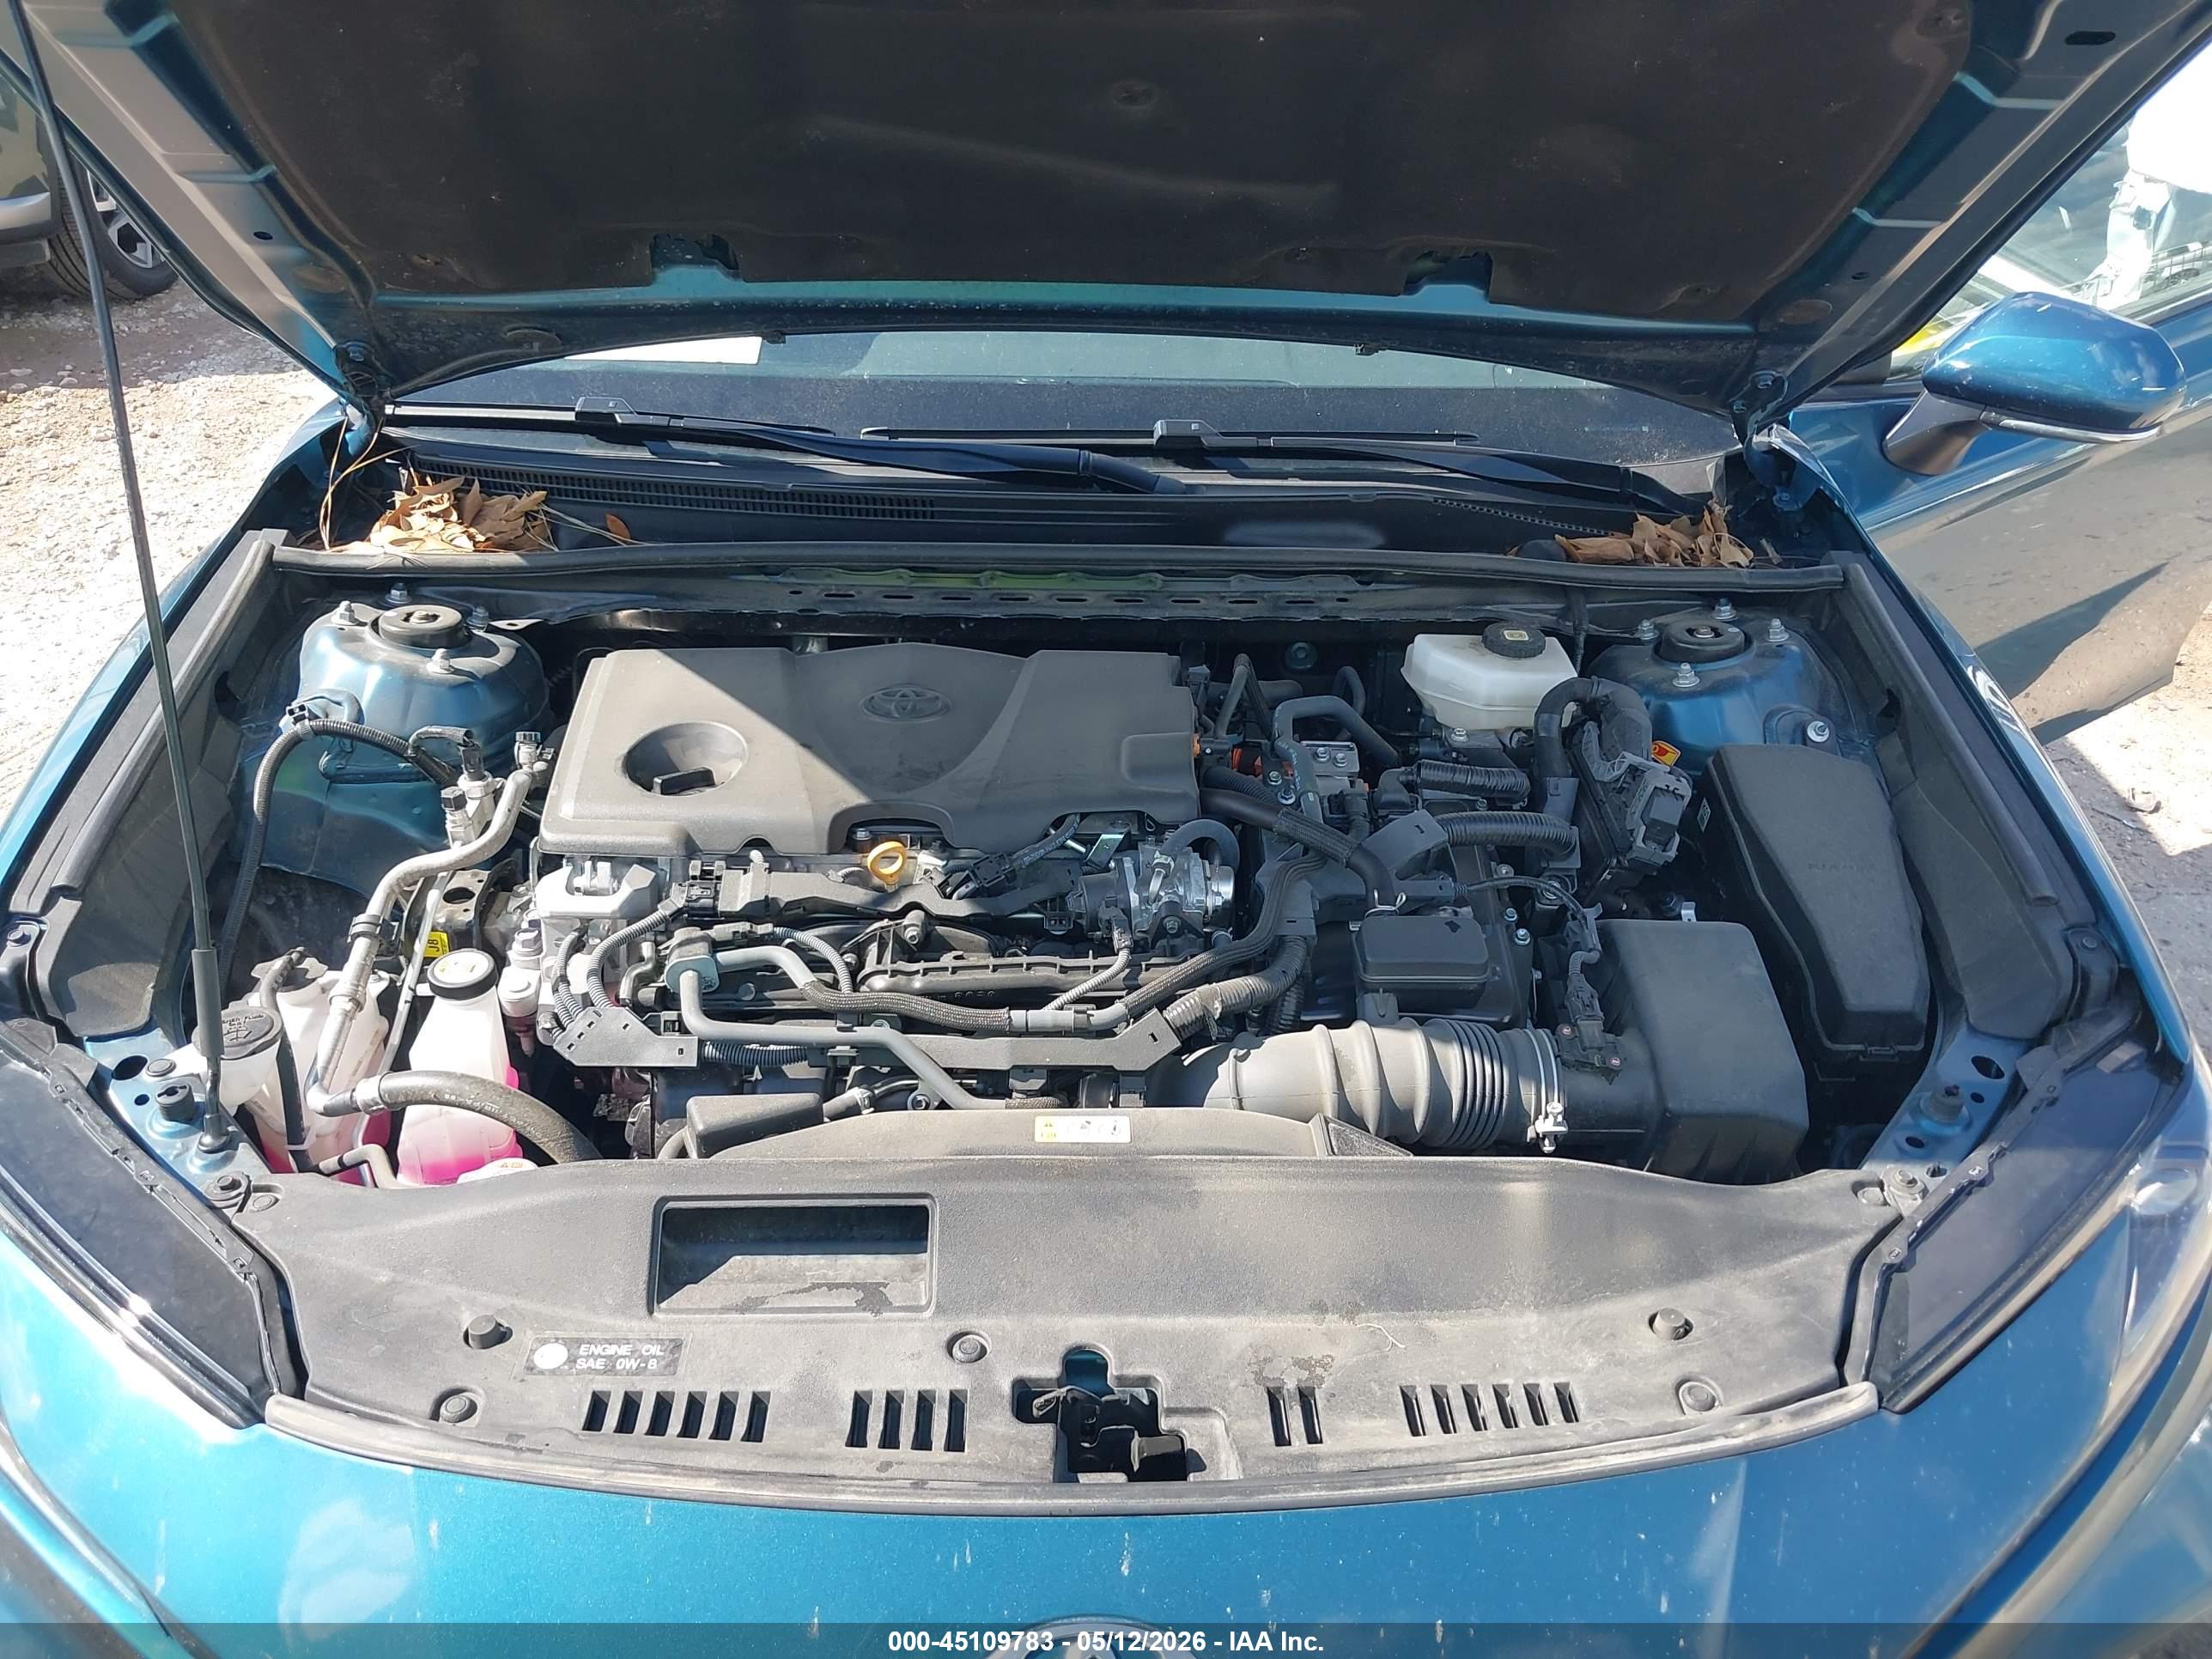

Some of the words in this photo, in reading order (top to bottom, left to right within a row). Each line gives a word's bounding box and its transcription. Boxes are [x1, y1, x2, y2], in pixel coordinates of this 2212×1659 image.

[579, 1344, 633, 1356] ENGINE
[641, 1344, 665, 1356] OIL
[575, 1358, 606, 1370] SAE
